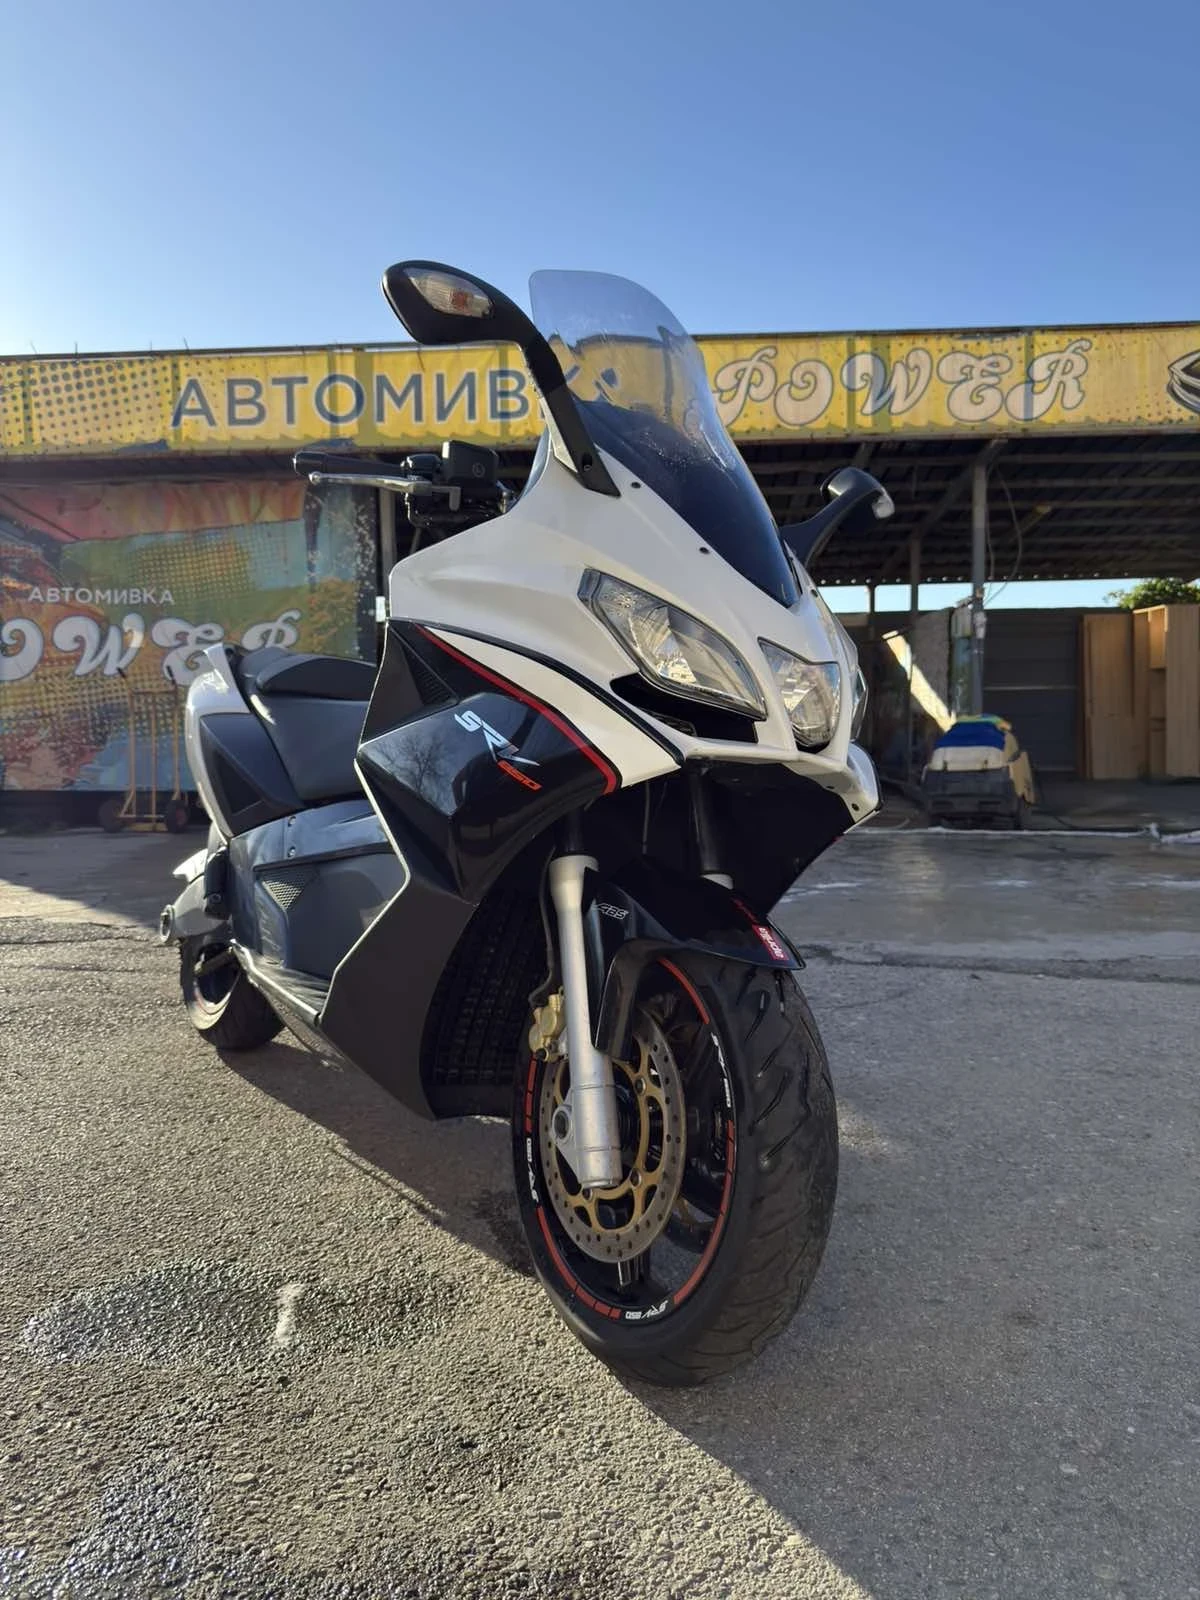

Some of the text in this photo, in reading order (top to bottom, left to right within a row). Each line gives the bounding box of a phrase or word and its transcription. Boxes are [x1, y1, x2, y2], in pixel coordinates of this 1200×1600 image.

[170, 368, 618, 429] АВТОМИВ
[709, 338, 1089, 427] POWER
[28, 586, 175, 606] АВТОМИВКА
